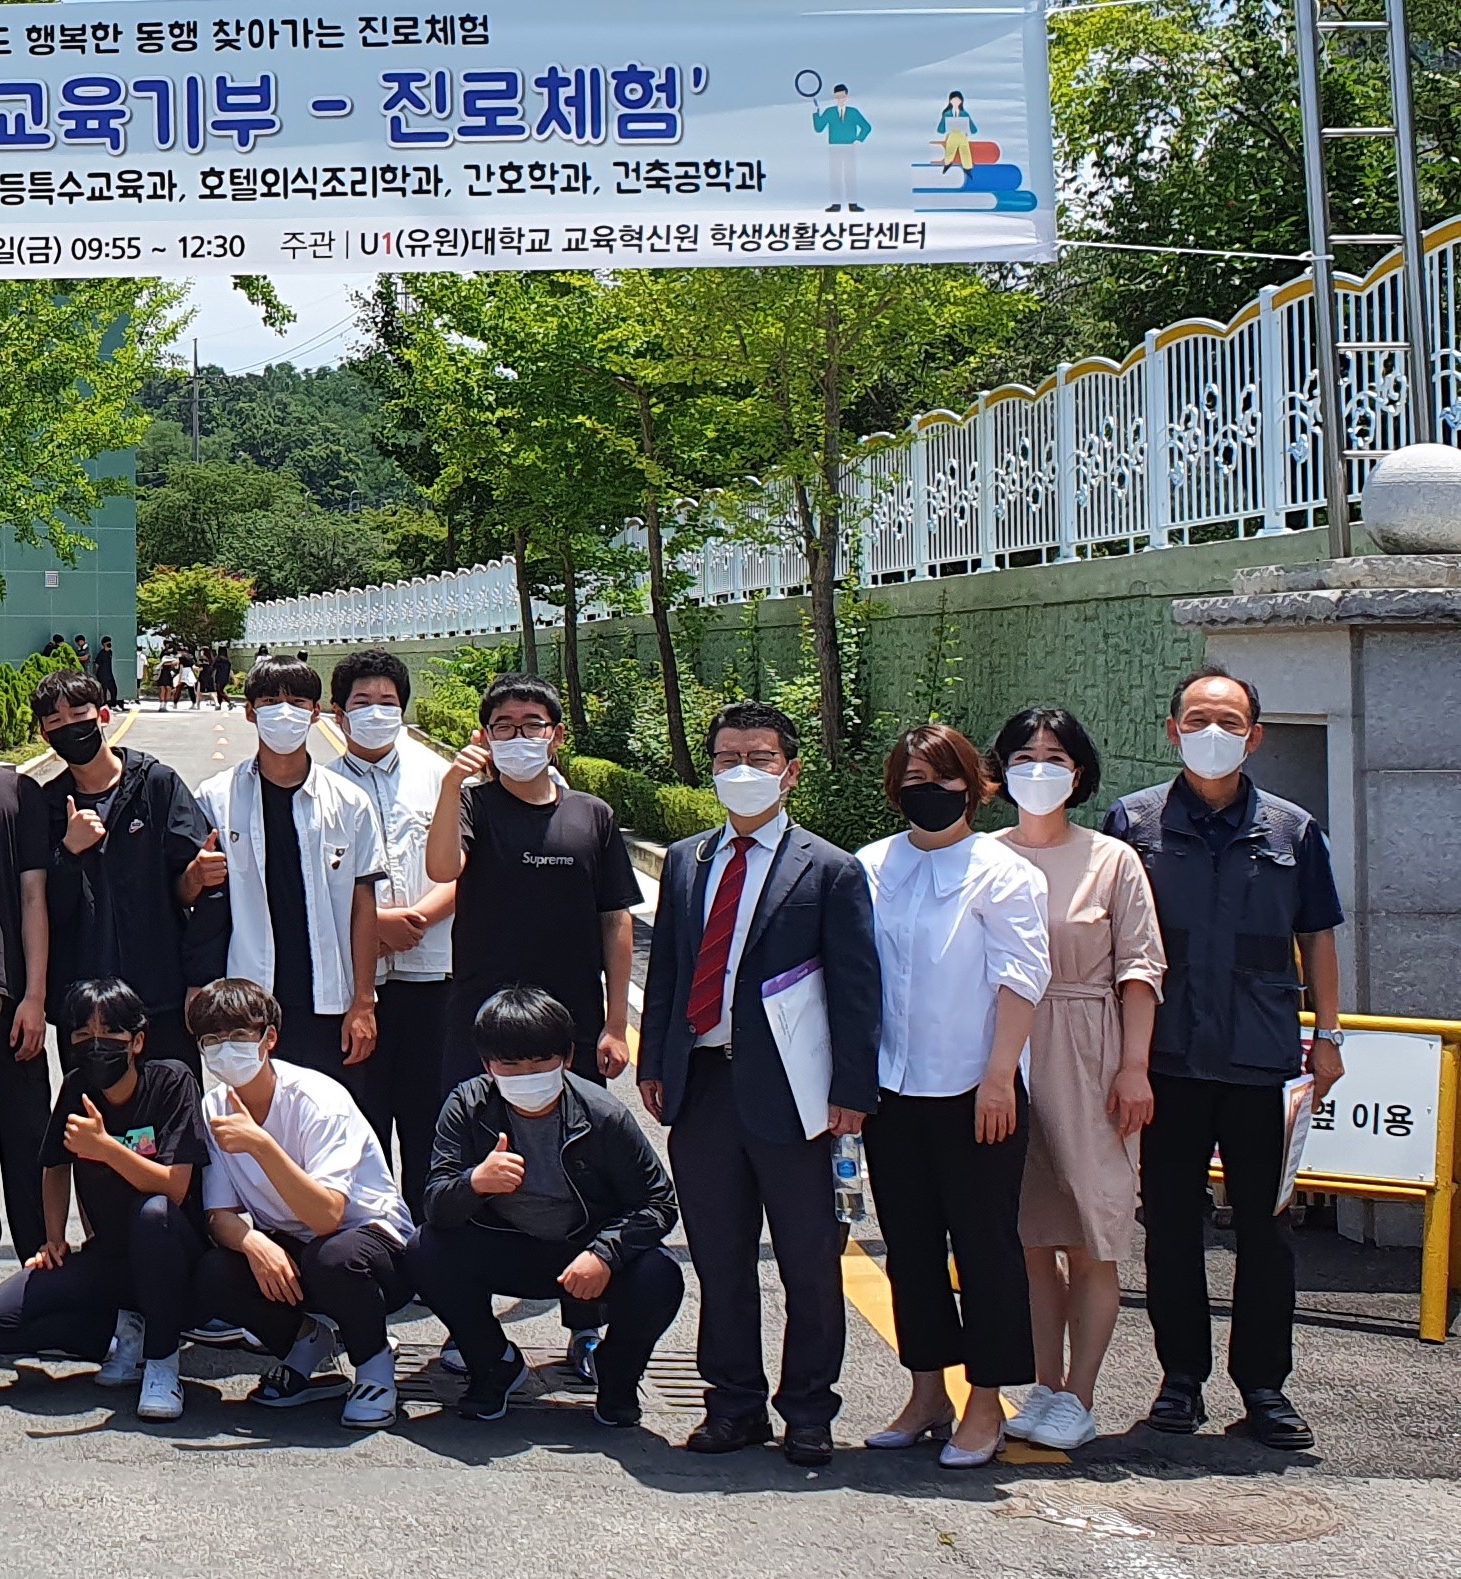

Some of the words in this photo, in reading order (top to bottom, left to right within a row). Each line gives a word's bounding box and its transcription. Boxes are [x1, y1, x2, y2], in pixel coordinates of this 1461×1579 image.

[26, 22, 123, 55] 행복한
[136, 21, 197, 53] 동행
[213, 18, 345, 51] 찾아가는
[358, 13, 489, 47] 진로체험
[199, 164, 451, 201] 호텔외식조리학과,
[464, 161, 599, 196] 간호학과,
[613, 159, 766, 194] 건축공학과
[71, 237, 141, 260] 09:55
[179, 235, 245, 258] 12:30
[281, 231, 335, 259] 주관
[361, 227, 552, 258] U1(유원)대학교
[562, 224, 698, 254] 교육혁신원
[710, 222, 925, 252] 학생생활상담센터
[522, 851, 574, 868] Supreme
[1352, 1101, 1414, 1137] 이용
